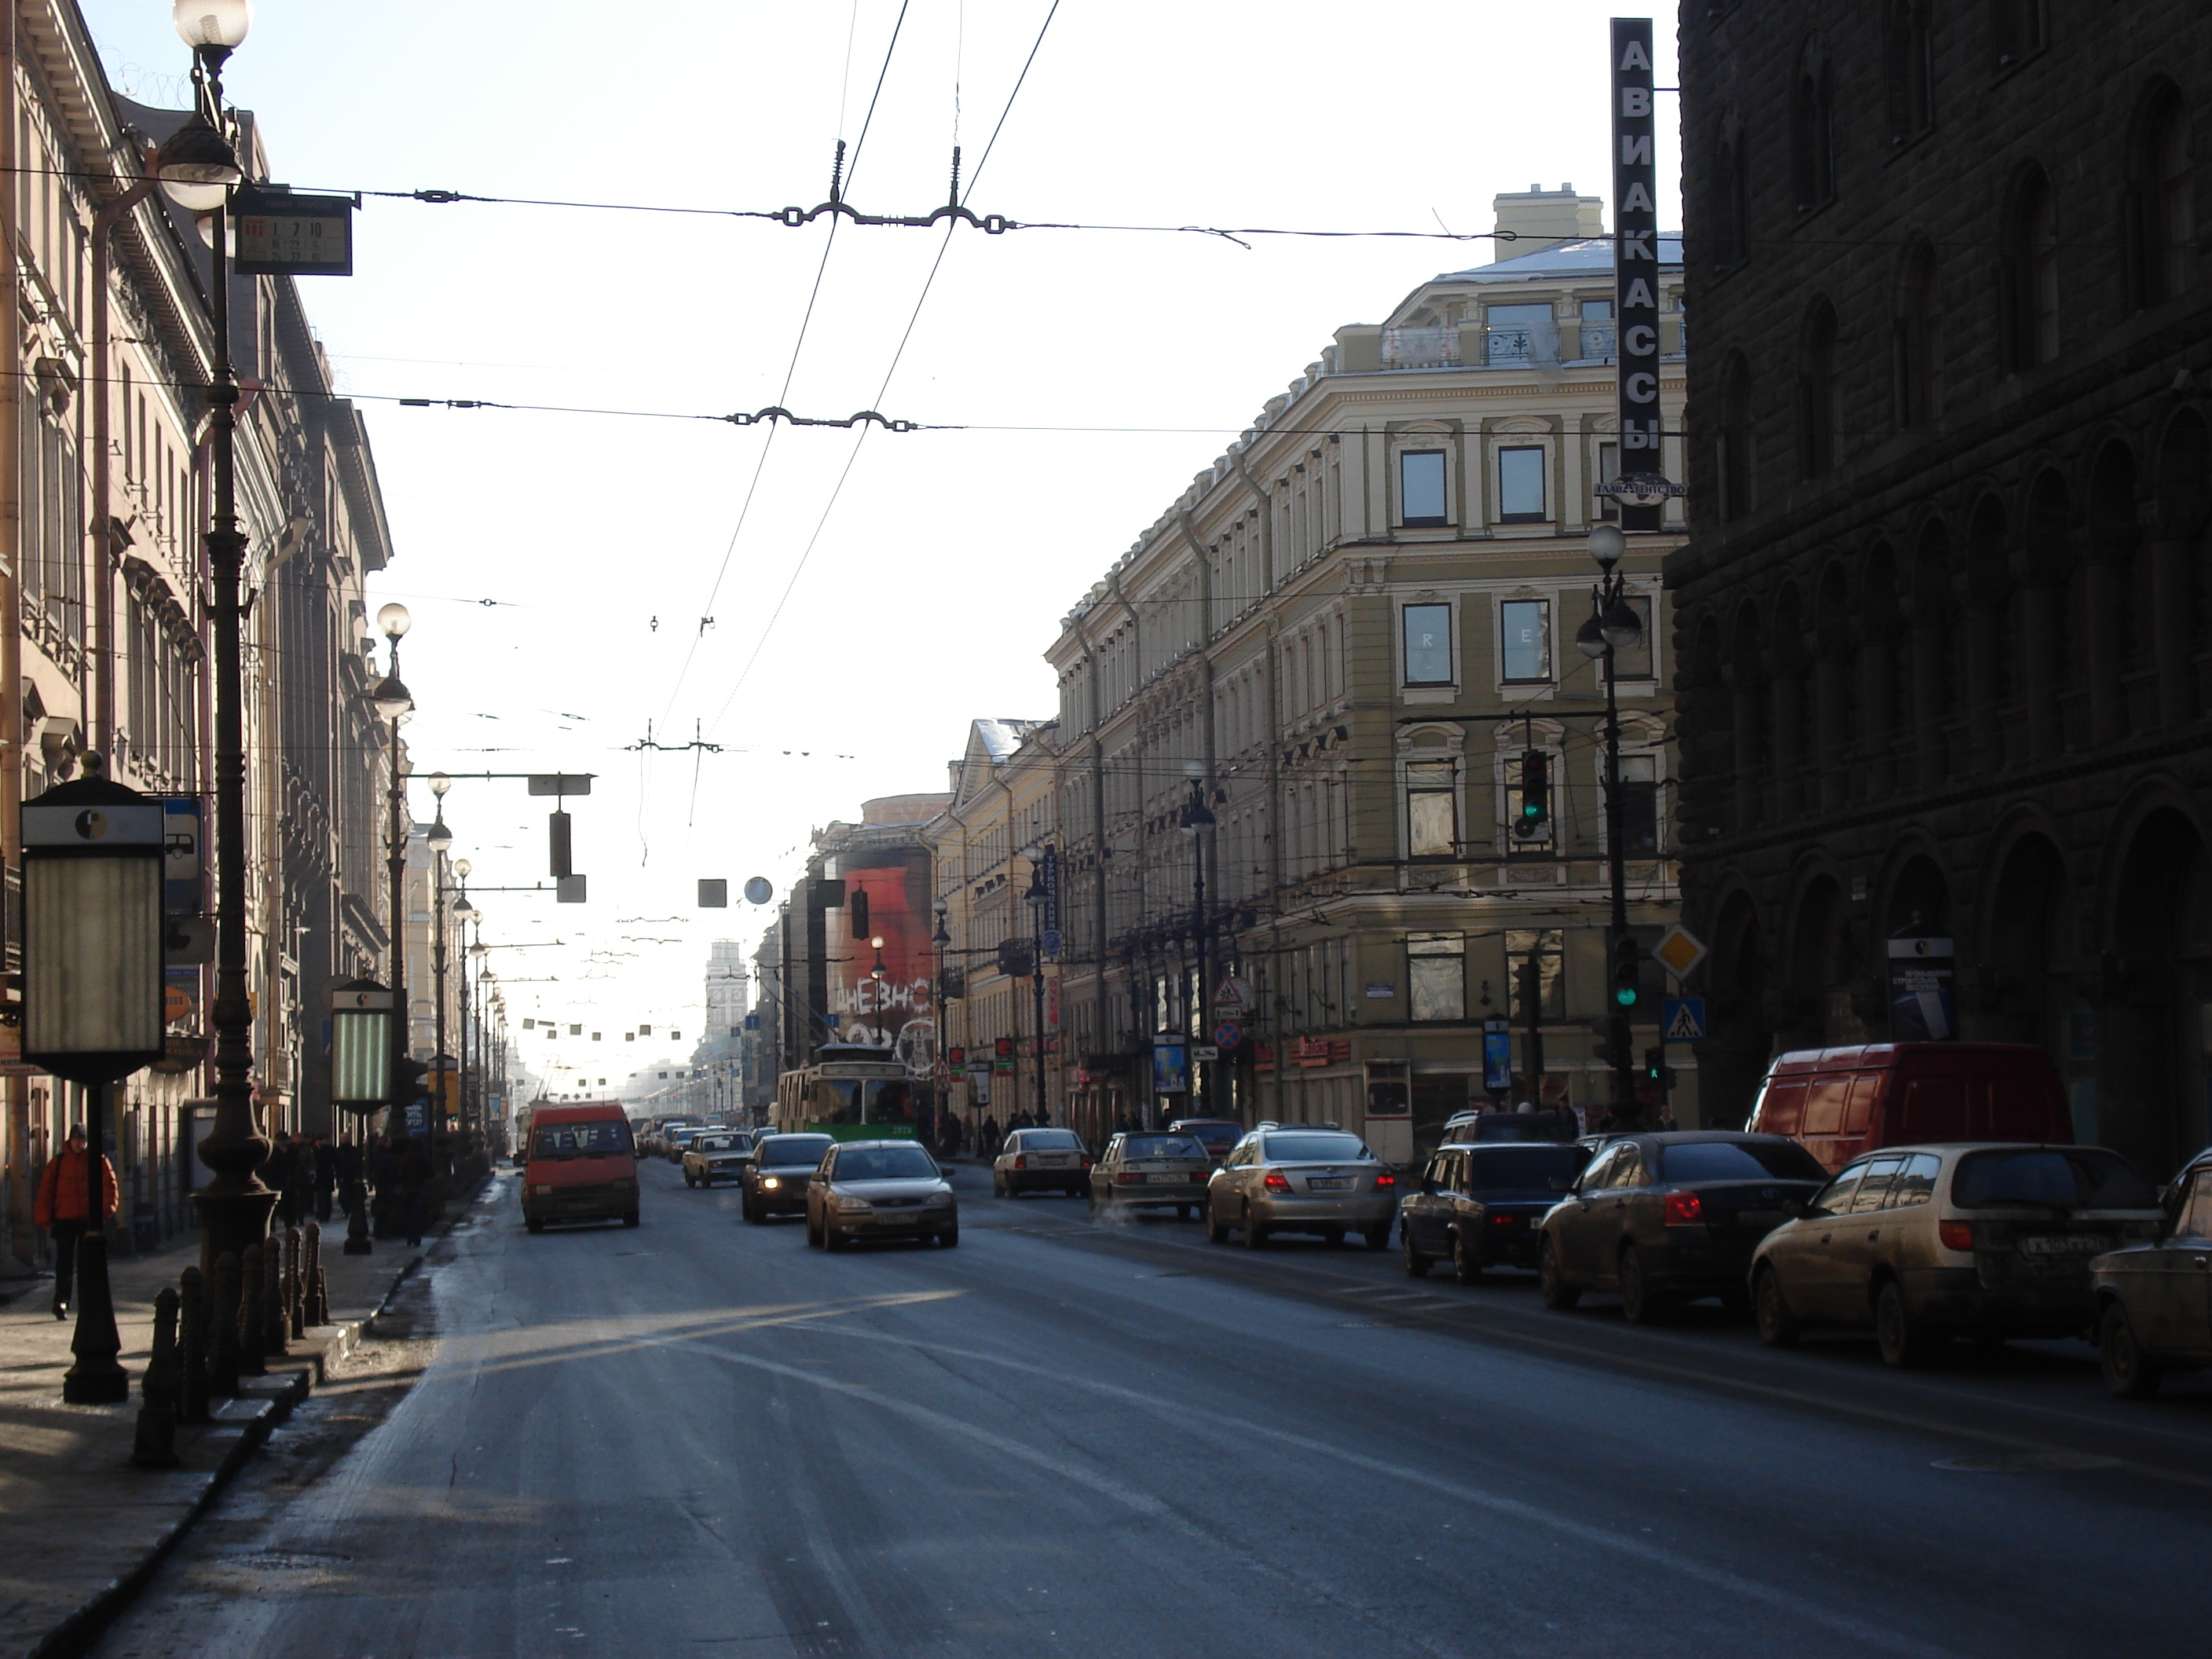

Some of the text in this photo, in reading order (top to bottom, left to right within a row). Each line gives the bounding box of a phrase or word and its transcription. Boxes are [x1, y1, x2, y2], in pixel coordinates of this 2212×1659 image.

[293, 222, 300, 236] 7
[310, 222, 321, 236] 10
[1620, 41, 1659, 449] АВИАКАССЫ
[1422, 629, 1531, 646] R E
